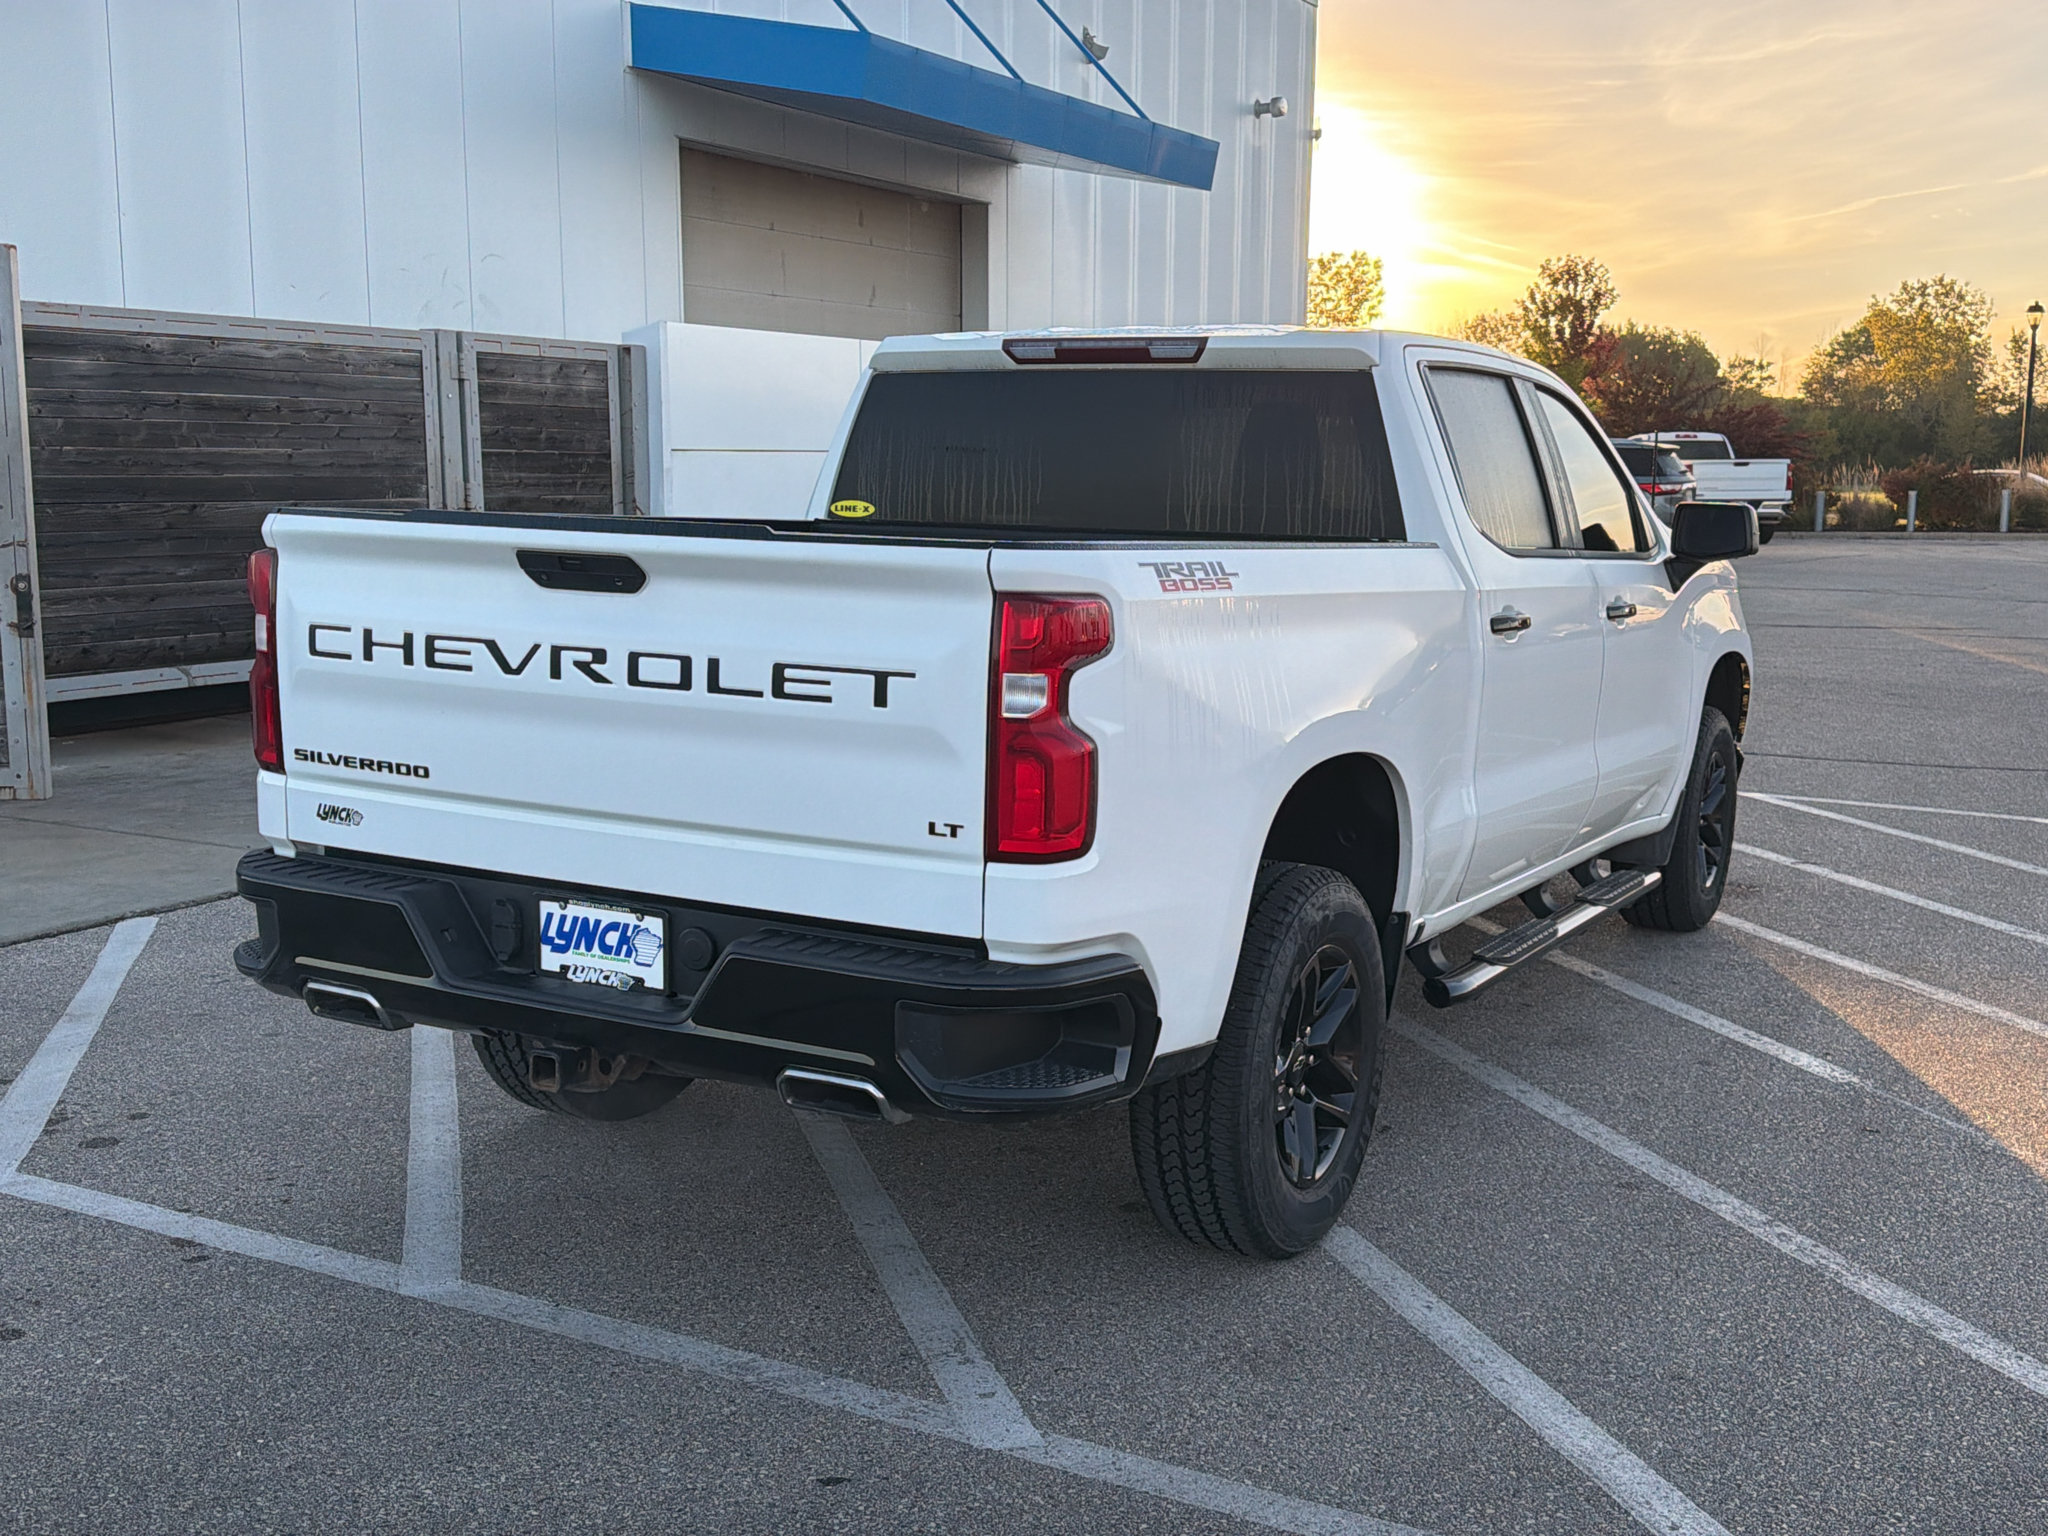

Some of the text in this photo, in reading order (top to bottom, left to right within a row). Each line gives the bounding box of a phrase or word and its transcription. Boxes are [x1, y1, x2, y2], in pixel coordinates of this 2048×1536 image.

[834, 504, 870, 513] LINE-X
[1138, 561, 1239, 578] TRAIL
[1159, 577, 1233, 592] BOSS
[308, 623, 916, 708] CHEVROLET
[294, 748, 430, 779] SILVERADO
[316, 803, 354, 823] LYNCH
[928, 821, 964, 838] LT
[568, 899, 631, 913] shoplynch.com
[540, 911, 641, 959] LYNCH
[566, 964, 619, 987] LYNCH
